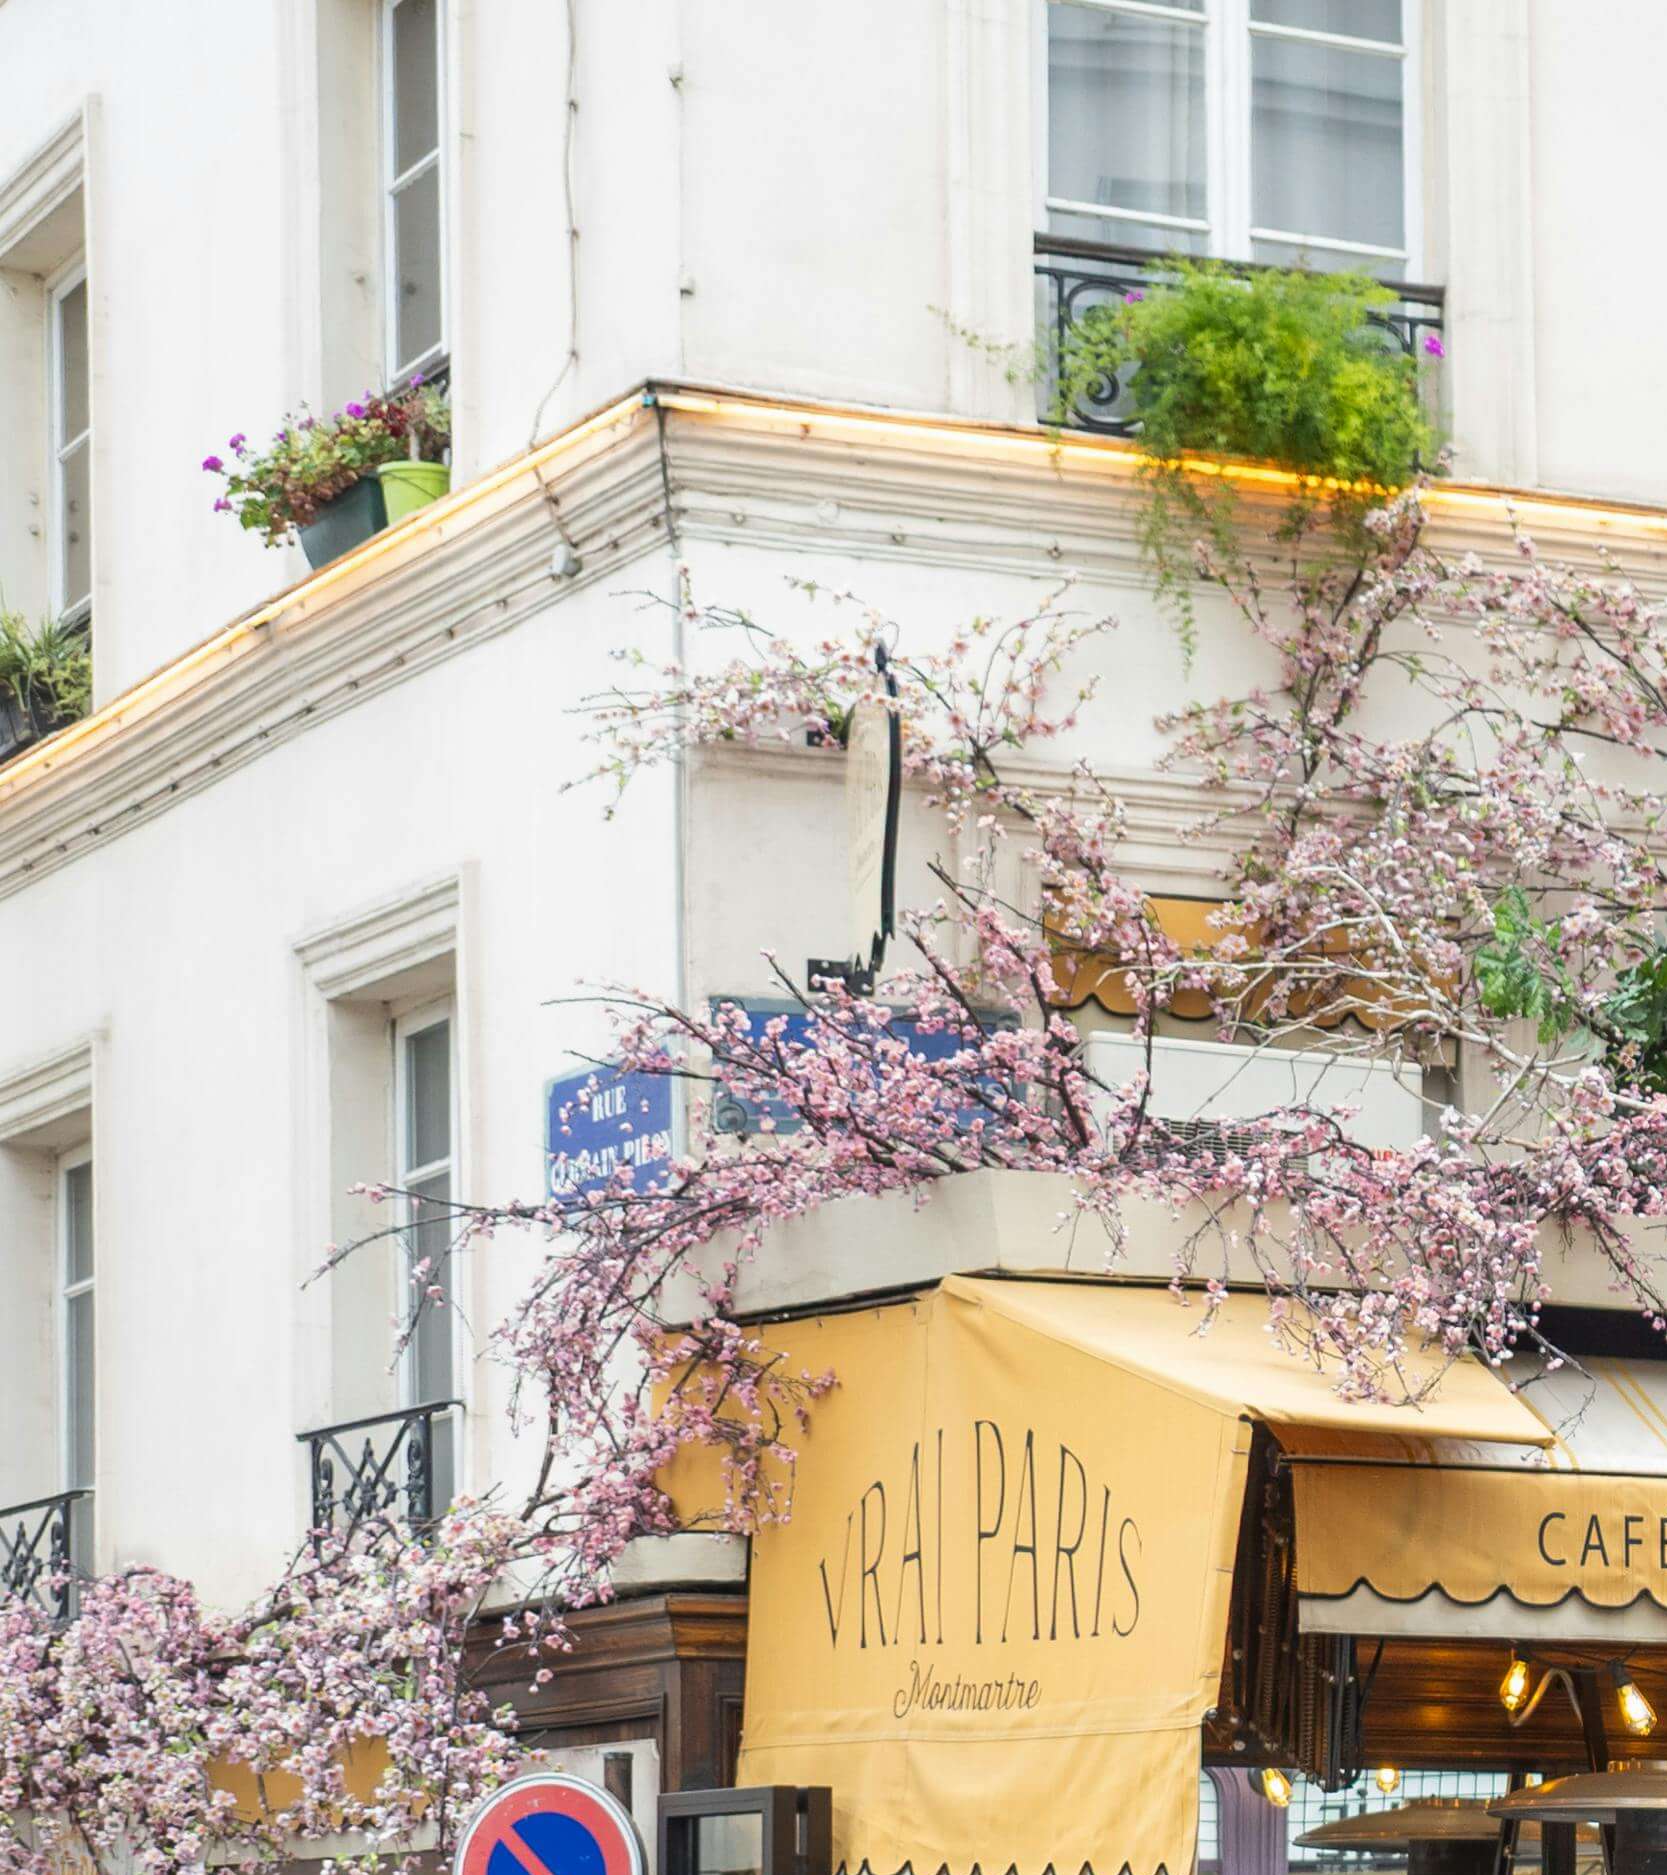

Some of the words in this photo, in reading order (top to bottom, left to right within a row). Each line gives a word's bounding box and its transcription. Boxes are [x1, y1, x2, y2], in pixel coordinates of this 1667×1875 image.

[592, 1085, 627, 1122] RUE
[819, 1428, 944, 1649] VRAI
[974, 1419, 1142, 1643] PARIS
[894, 1659, 1042, 1718] Montmartre
